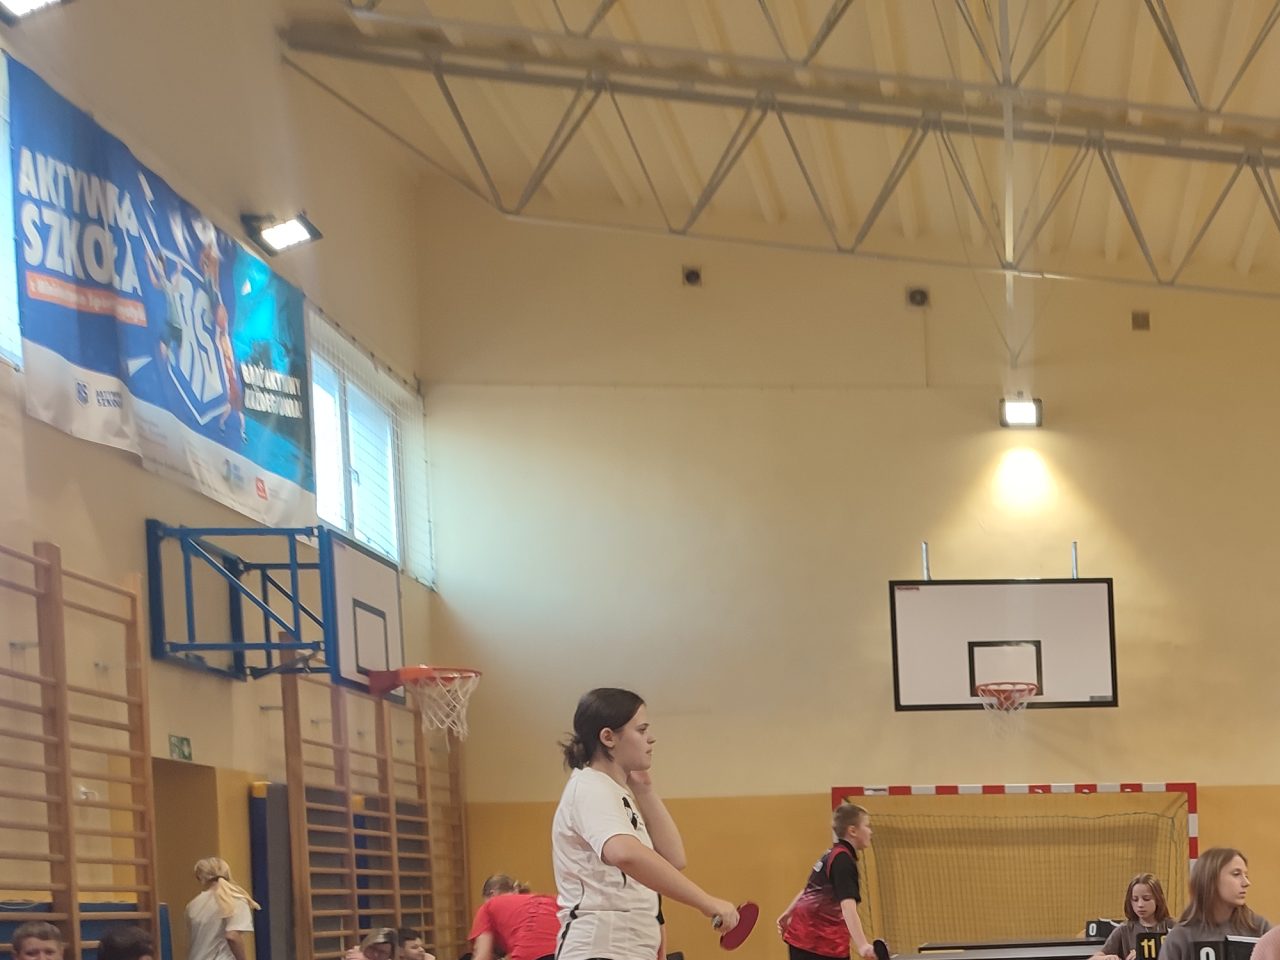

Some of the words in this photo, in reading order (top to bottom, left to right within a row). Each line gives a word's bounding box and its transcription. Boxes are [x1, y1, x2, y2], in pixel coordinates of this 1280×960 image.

[18, 146, 139, 238] AKTYWNA
[21, 202, 143, 297] SZKOŁA
[1140, 938, 1156, 959] 11
